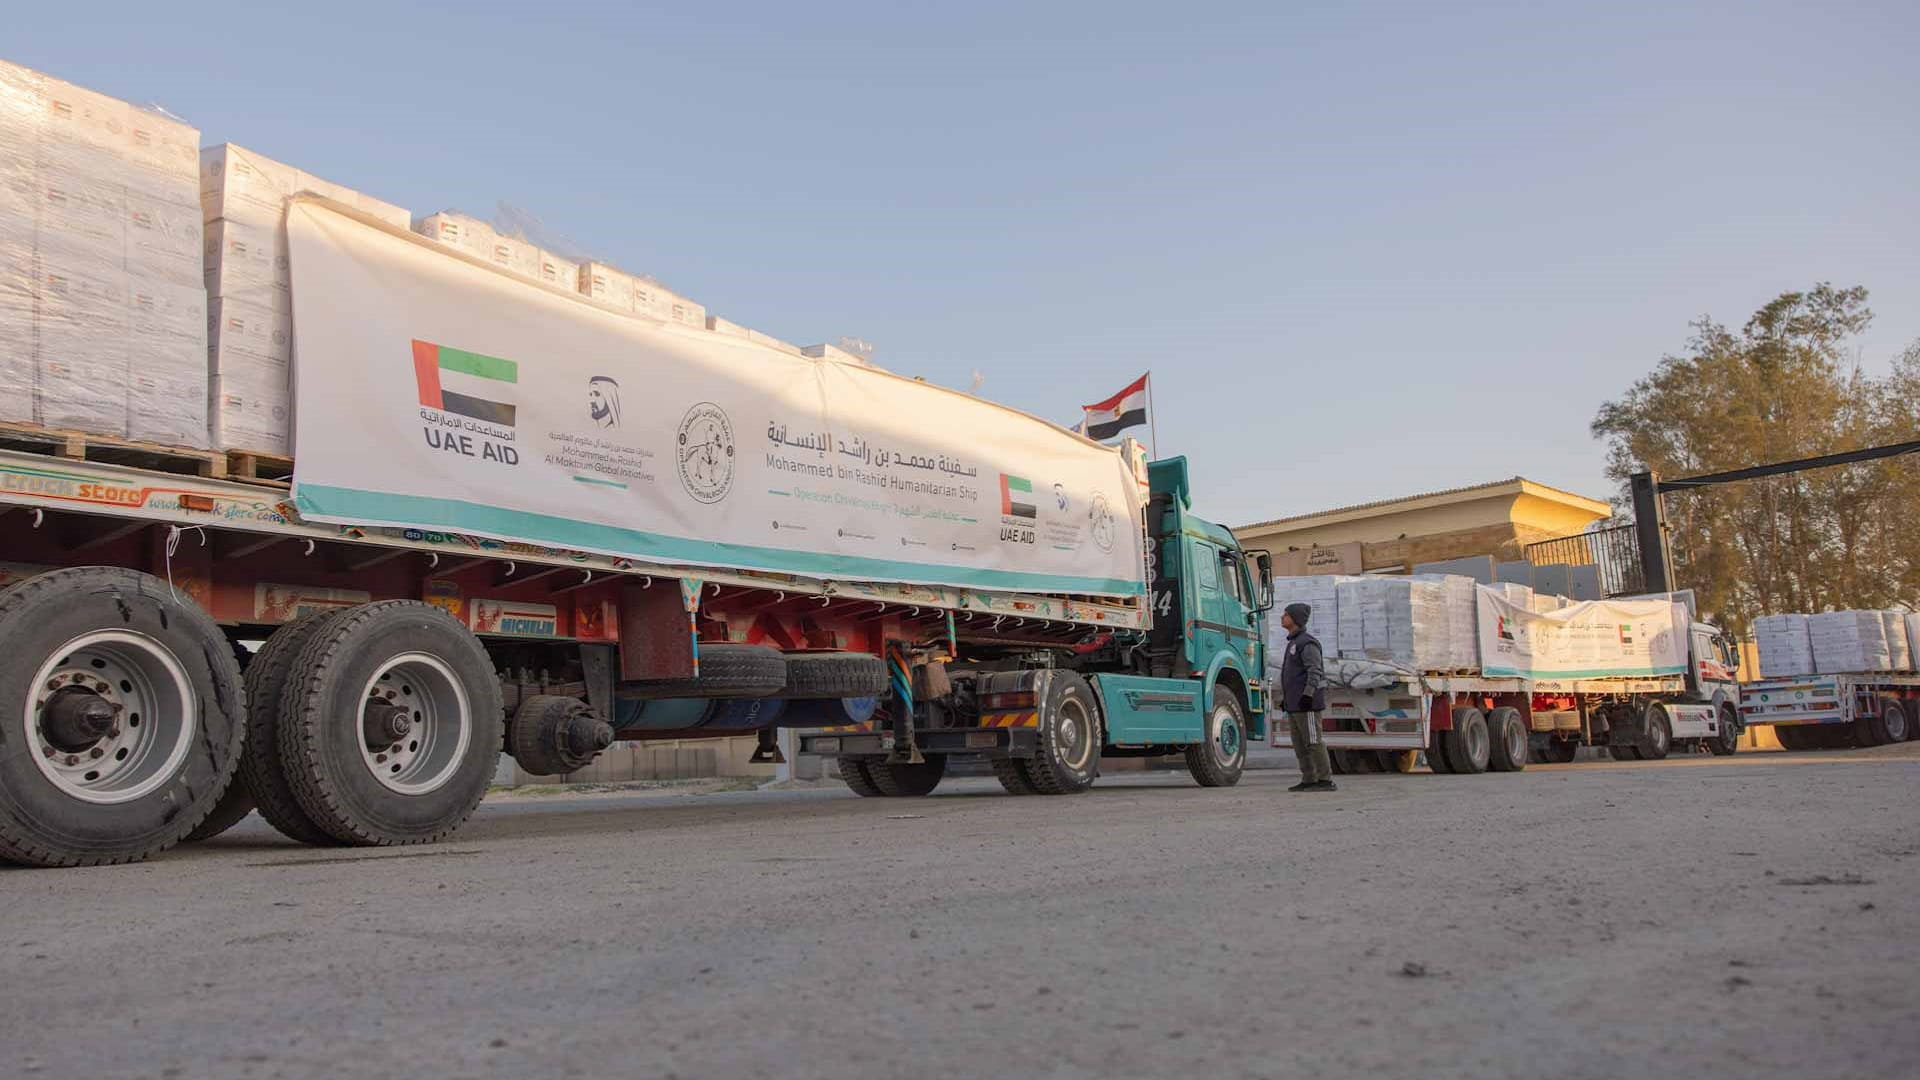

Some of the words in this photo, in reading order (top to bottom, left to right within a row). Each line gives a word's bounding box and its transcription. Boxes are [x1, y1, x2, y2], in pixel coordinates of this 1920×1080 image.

[464, 422, 516, 441] المساعدات
[767, 421, 832, 459] الإنسانية
[424, 427, 475, 457] UAE
[482, 441, 519, 466] AID
[562, 446, 609, 461] Mohammed
[838, 437, 871, 465] راشد
[875, 448, 889, 468] بن
[594, 462, 618, 475] Global
[766, 453, 833, 478] Mohammed
[838, 464, 853, 480] bin
[856, 468, 887, 488] Rashid
[890, 475, 957, 497] Humanitarian
[959, 485, 977, 502] Ship
[406, 531, 420, 539] 80
[428, 533, 441, 541] 70
[1001, 528, 1018, 542] UAE
[1020, 530, 1035, 544] AID
